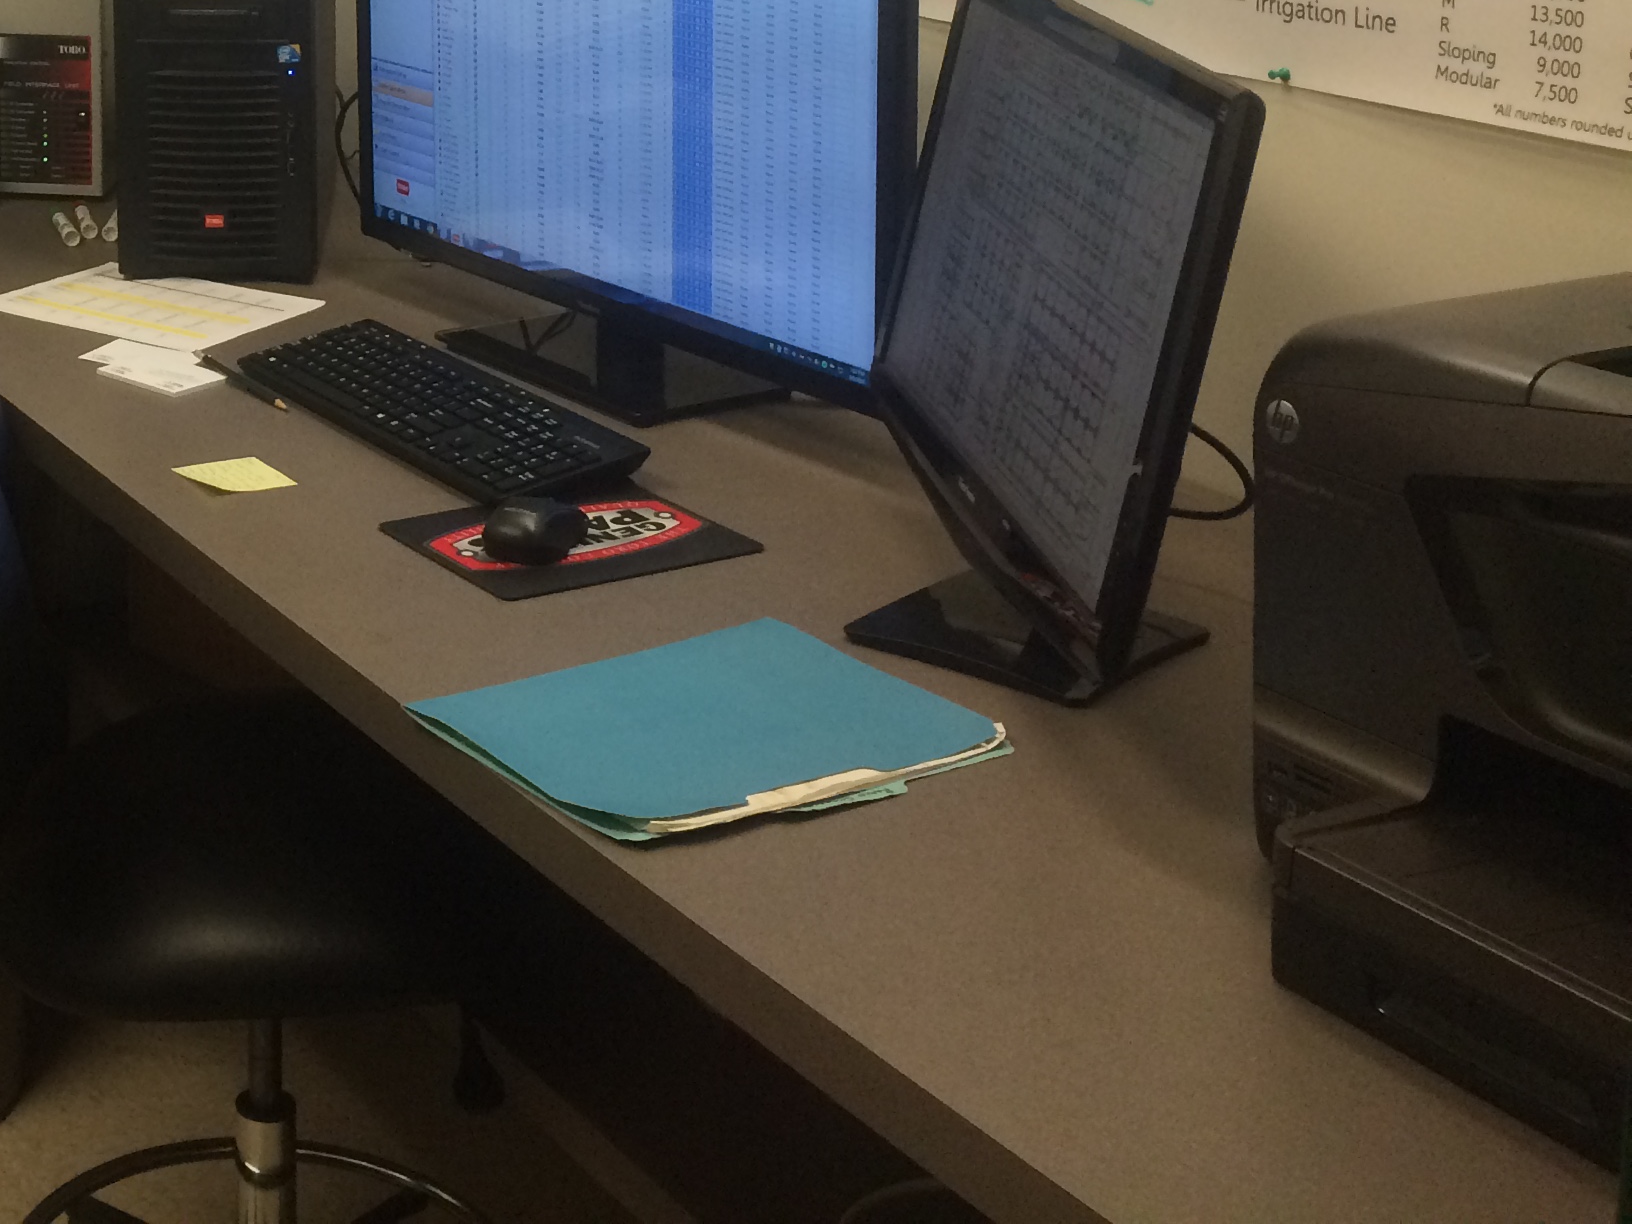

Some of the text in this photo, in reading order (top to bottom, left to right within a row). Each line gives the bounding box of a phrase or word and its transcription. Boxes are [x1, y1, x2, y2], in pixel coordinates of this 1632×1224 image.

[1354, 6, 1397, 34] Line
[1530, 5, 1585, 29] 13,500
[1440, 16, 1583, 54] R 14,000
[58, 45, 86, 54] TORO
[1438, 41, 1581, 78] Sloping 9,000
[1435, 64, 1578, 104] Modular 7,500
[1570, 120, 1624, 138] rounded
